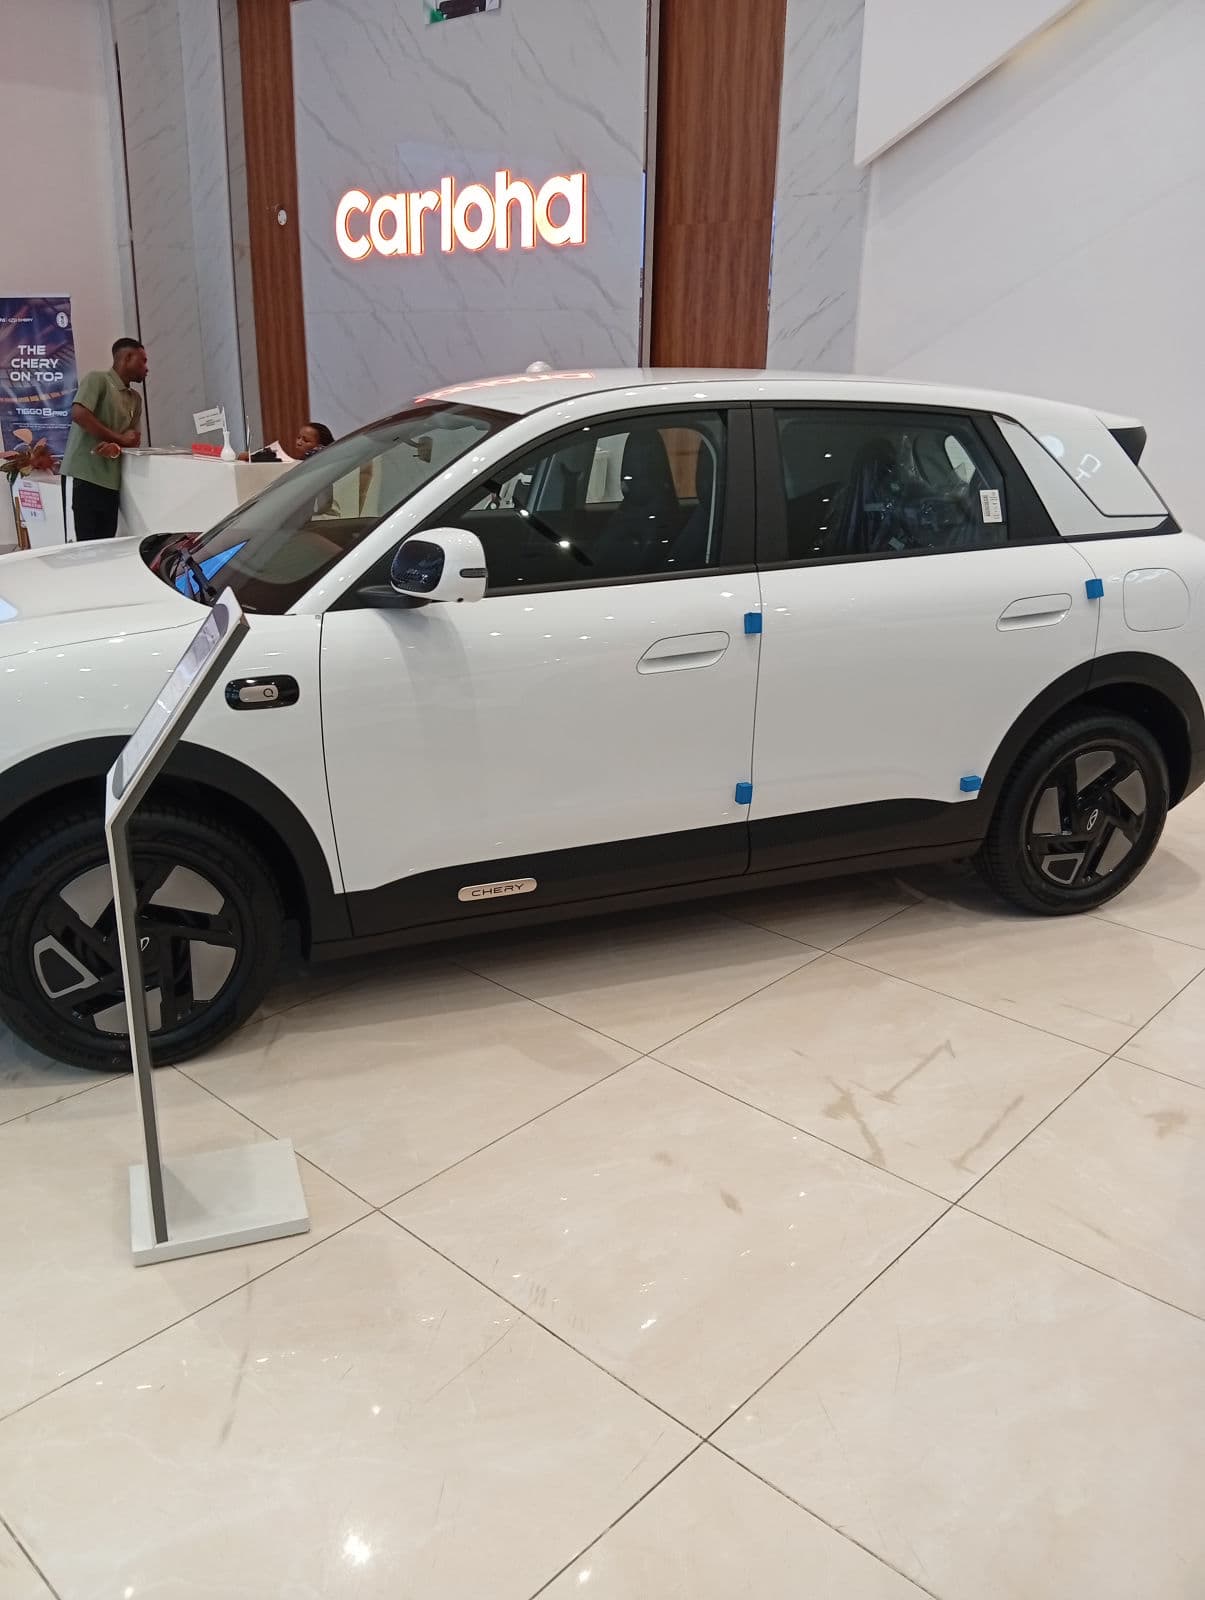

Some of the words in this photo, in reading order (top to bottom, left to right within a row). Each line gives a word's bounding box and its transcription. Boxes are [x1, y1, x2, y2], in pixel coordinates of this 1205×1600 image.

[335, 169, 586, 260] carloha
[17, 344, 46, 355] THE
[11, 358, 59, 369] CHERY
[10, 371, 31, 381] ON
[34, 371, 64, 382] TOP
[471, 883, 524, 897] CHERY
